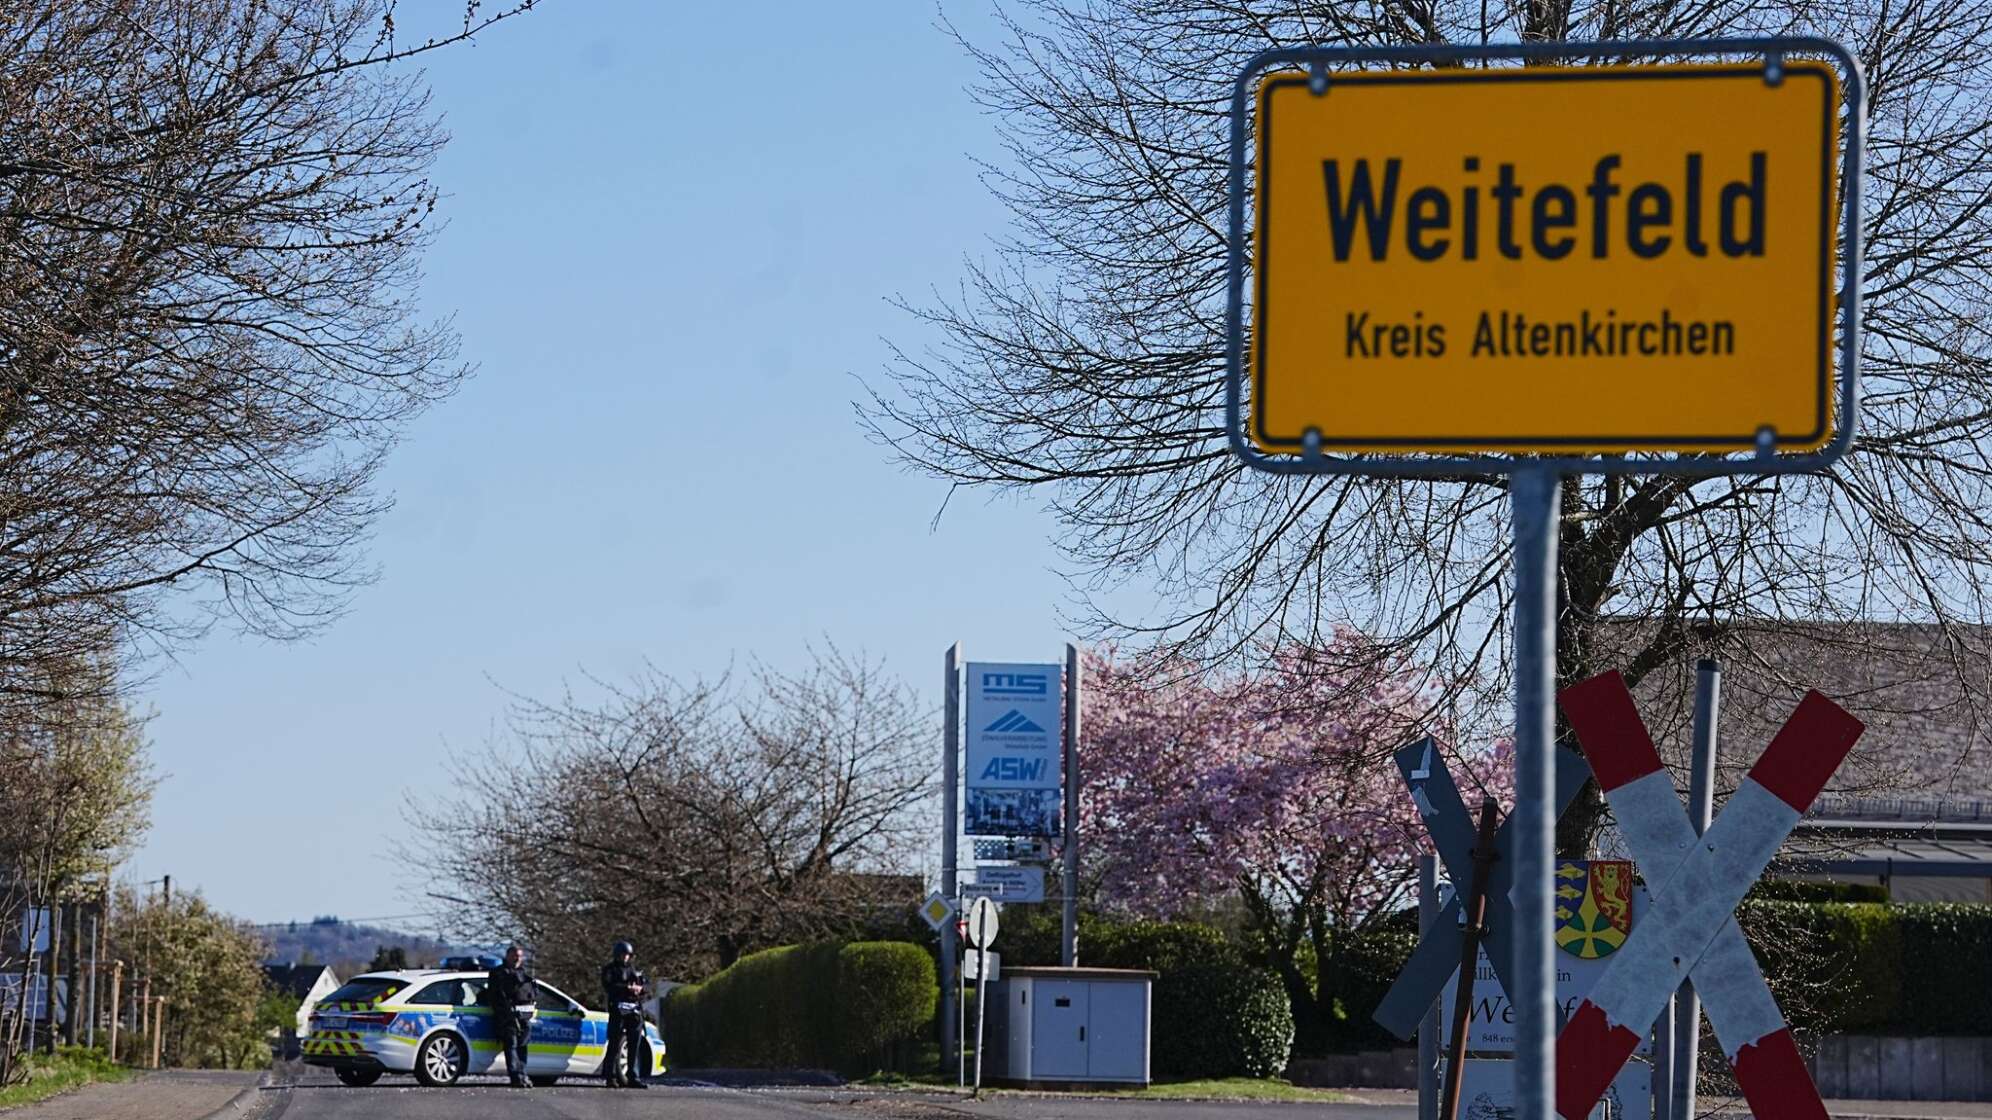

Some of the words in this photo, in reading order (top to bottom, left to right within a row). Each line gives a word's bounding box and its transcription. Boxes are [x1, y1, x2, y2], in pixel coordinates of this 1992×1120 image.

[1322, 152, 1767, 262] Weitefeld
[1346, 311, 1446, 359] Kreis
[1471, 310, 1735, 357] Altenkirchen
[980, 757, 1040, 782] ASW
[1556, 968, 1571, 982] in
